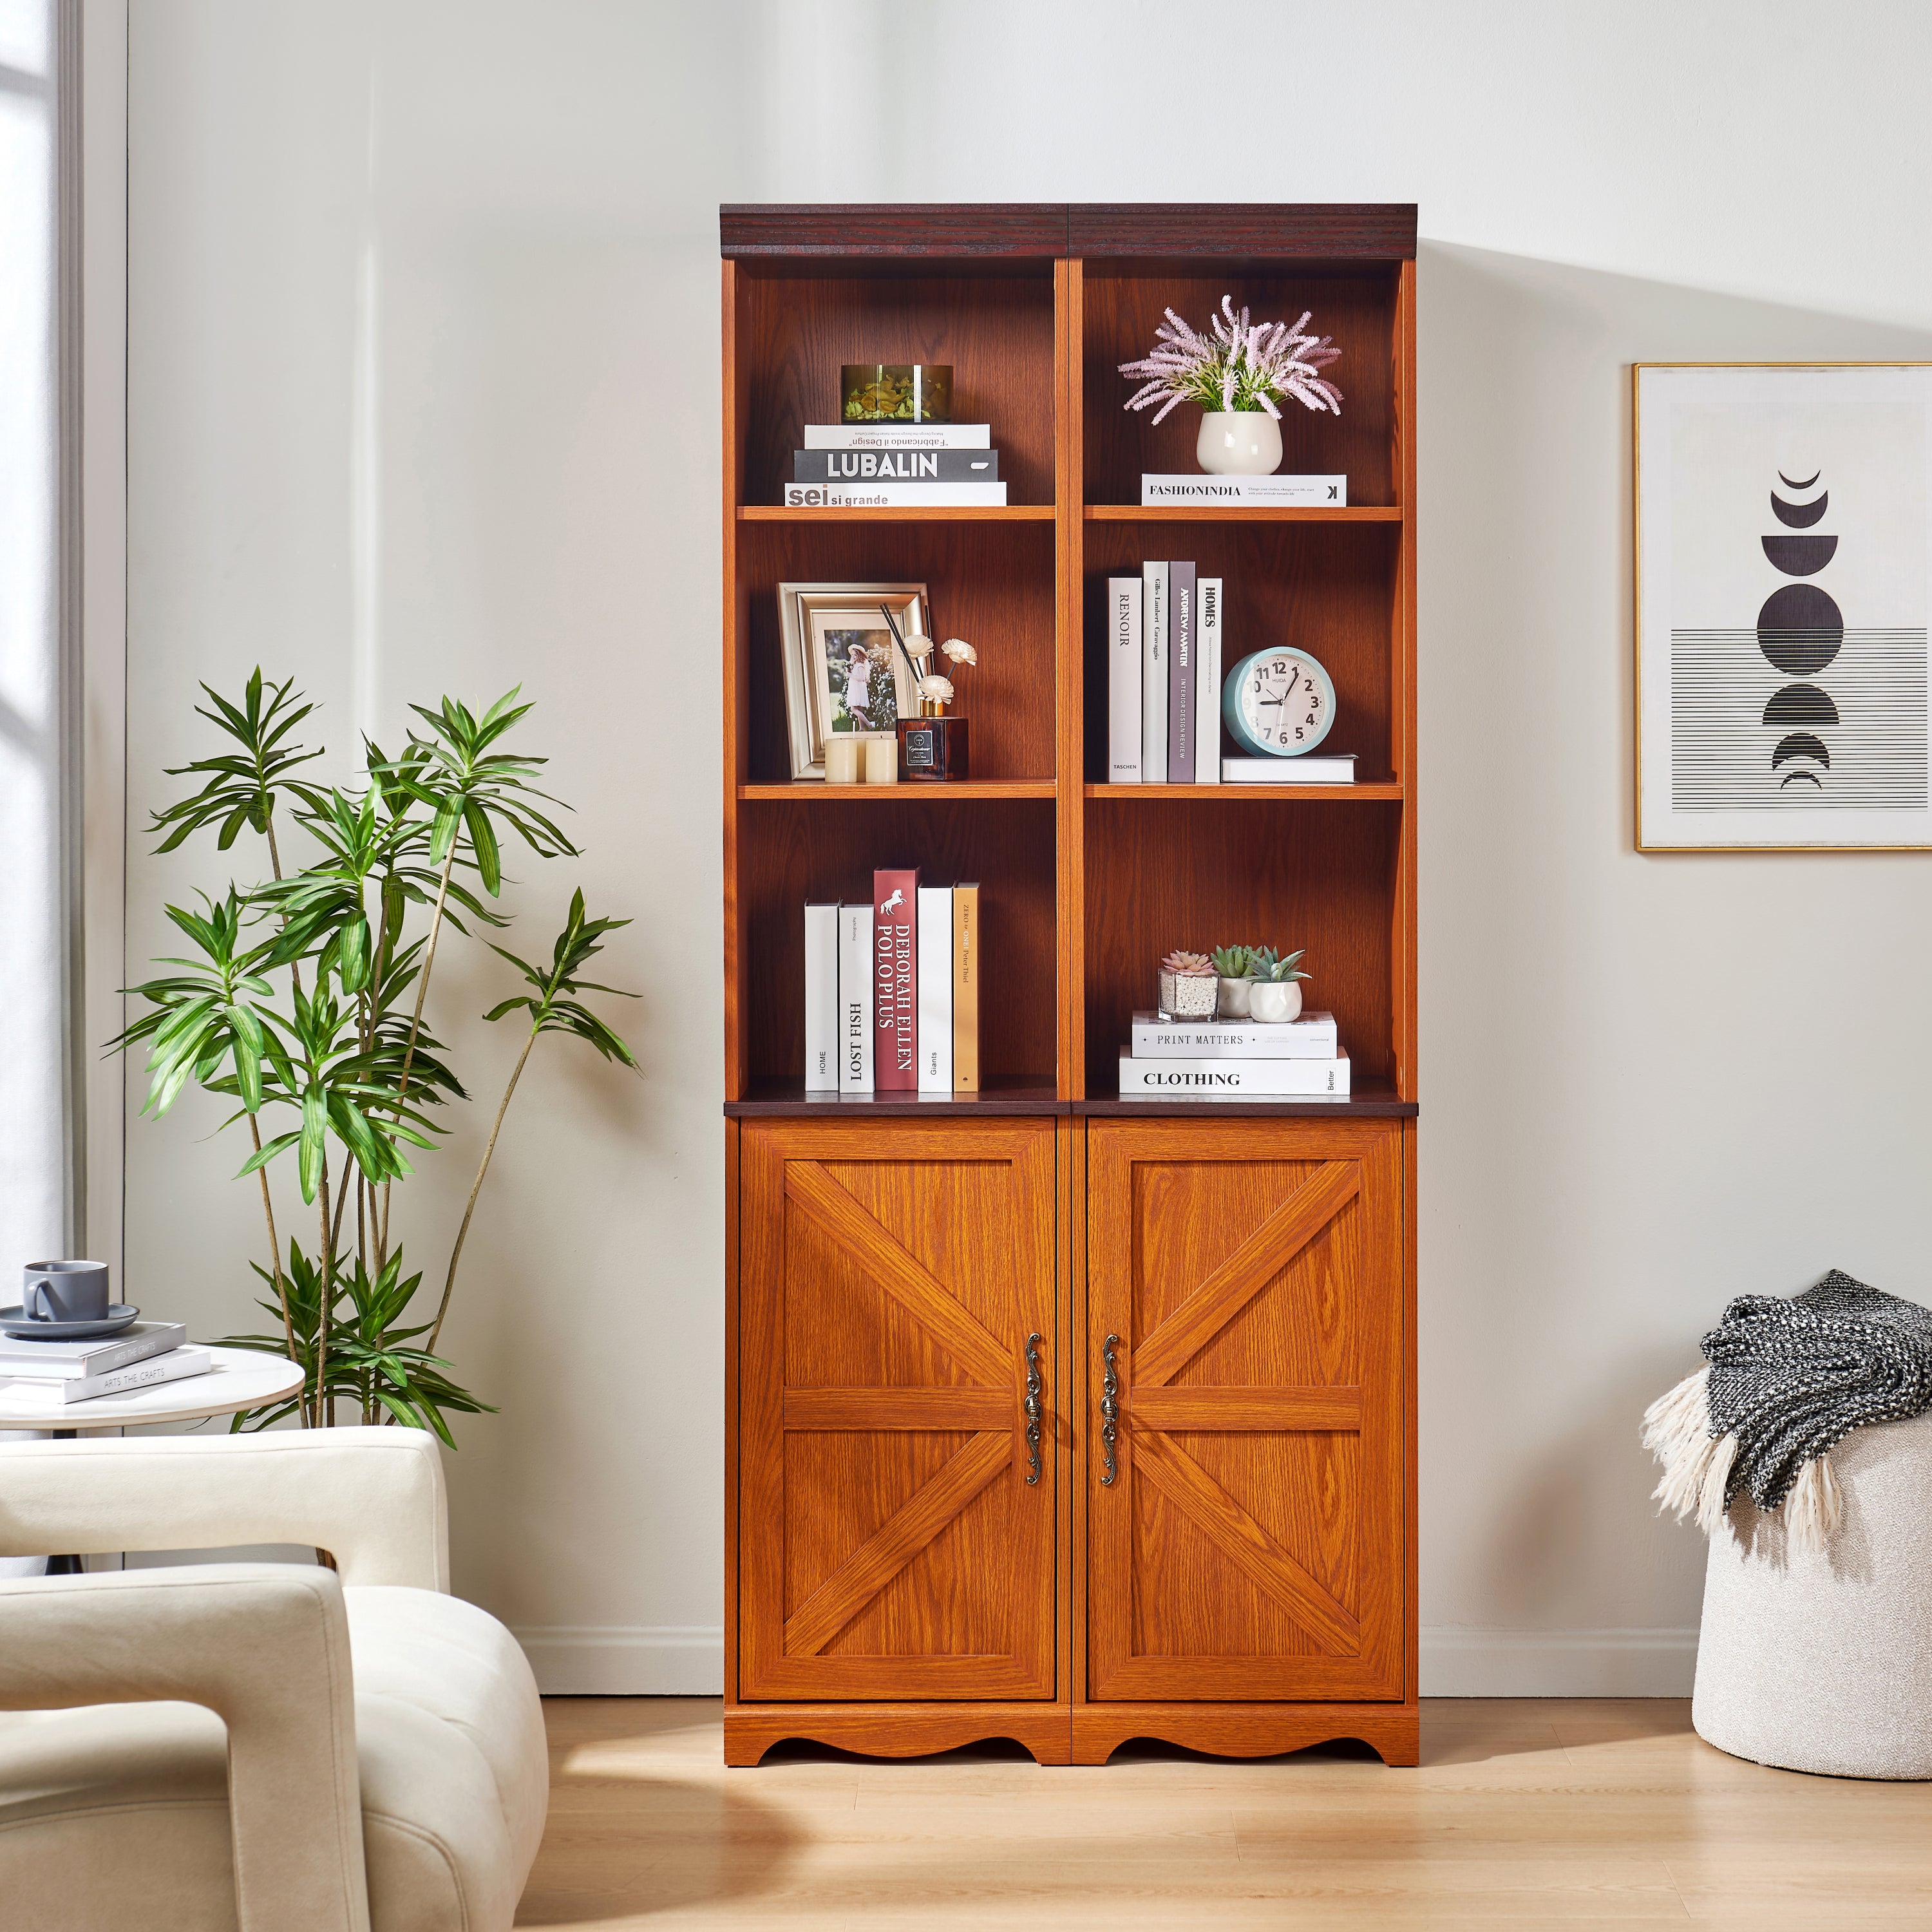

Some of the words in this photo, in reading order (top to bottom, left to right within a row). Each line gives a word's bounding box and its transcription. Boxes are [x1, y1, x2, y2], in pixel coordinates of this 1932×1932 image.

[828, 453, 938, 477] LUBALIN
[789, 484, 828, 506] sei
[831, 495, 841, 505] si
[845, 495, 888, 506] grande
[1150, 486, 1241, 496] FASHIONINDIA
[1180, 587, 1189, 630] ANDREW
[1206, 587, 1215, 628] HOMES
[1119, 594, 1130, 647] RENOIR
[1180, 630, 1188, 667] MARTIN
[1256, 667, 1269, 679] 11
[1272, 662, 1287, 674] 12
[1291, 667, 1299, 678] 1
[1305, 679, 1312, 692] 2
[1311, 697, 1319, 708] 3
[1306, 714, 1315, 725] 4
[1264, 728, 1271, 739] 7
[1279, 732, 1288, 744] 6
[1295, 727, 1303, 739] 5
[877, 925, 893, 980] POLO
[896, 925, 911, 1010] DEBORAH
[878, 983, 894, 1029] PLUS
[850, 1002, 862, 1037] FISH
[896, 1016, 912, 1071] ELLEN
[1157, 1035, 1191, 1044] PRINT
[1196, 1035, 1243, 1044] MATTERS
[850, 1042, 862, 1081] LOST
[1144, 1073, 1240, 1086] CLOTHING
[114, 1350, 126, 1362] ARTS
[128, 1347, 137, 1357] THE
[138, 1341, 155, 1355] CRAFTS
[104, 1377, 121, 1388] ARTS
[124, 1373, 138, 1383] THE
[140, 1368, 165, 1381] CRAFTS
